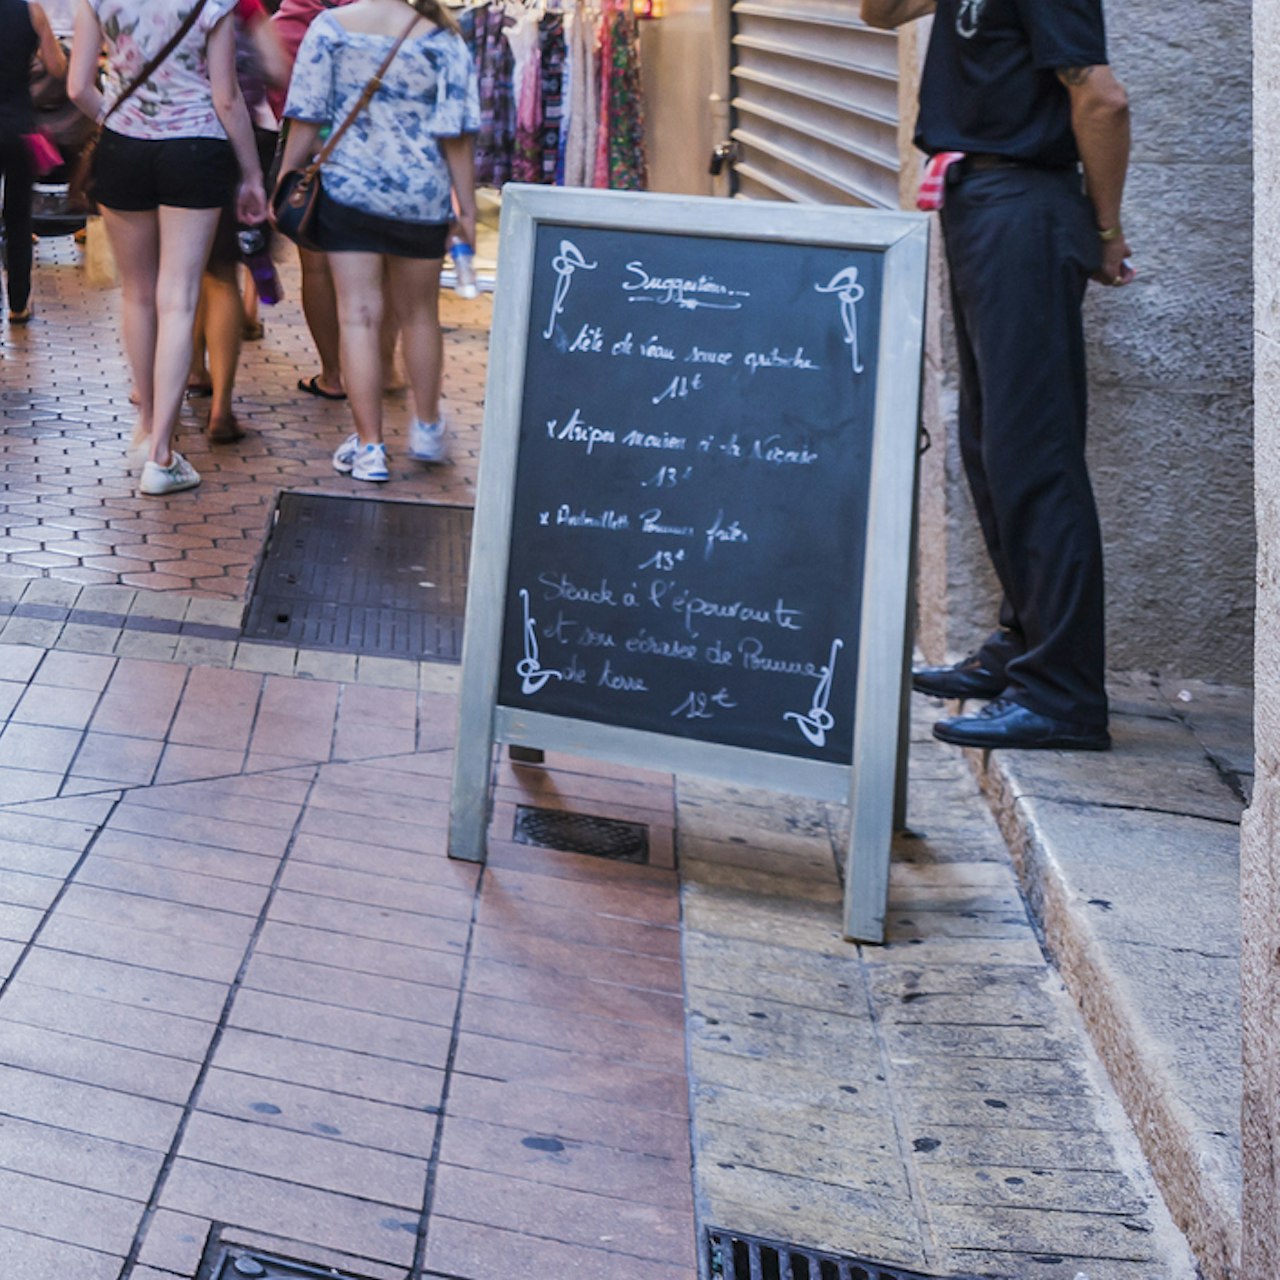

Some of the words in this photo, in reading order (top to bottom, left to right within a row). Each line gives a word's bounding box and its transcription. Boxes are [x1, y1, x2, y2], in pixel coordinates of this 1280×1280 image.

[539, 572, 617, 606] Steack
[622, 581, 639, 607] à
[542, 611, 578, 643] et
[704, 640, 733, 666] de
